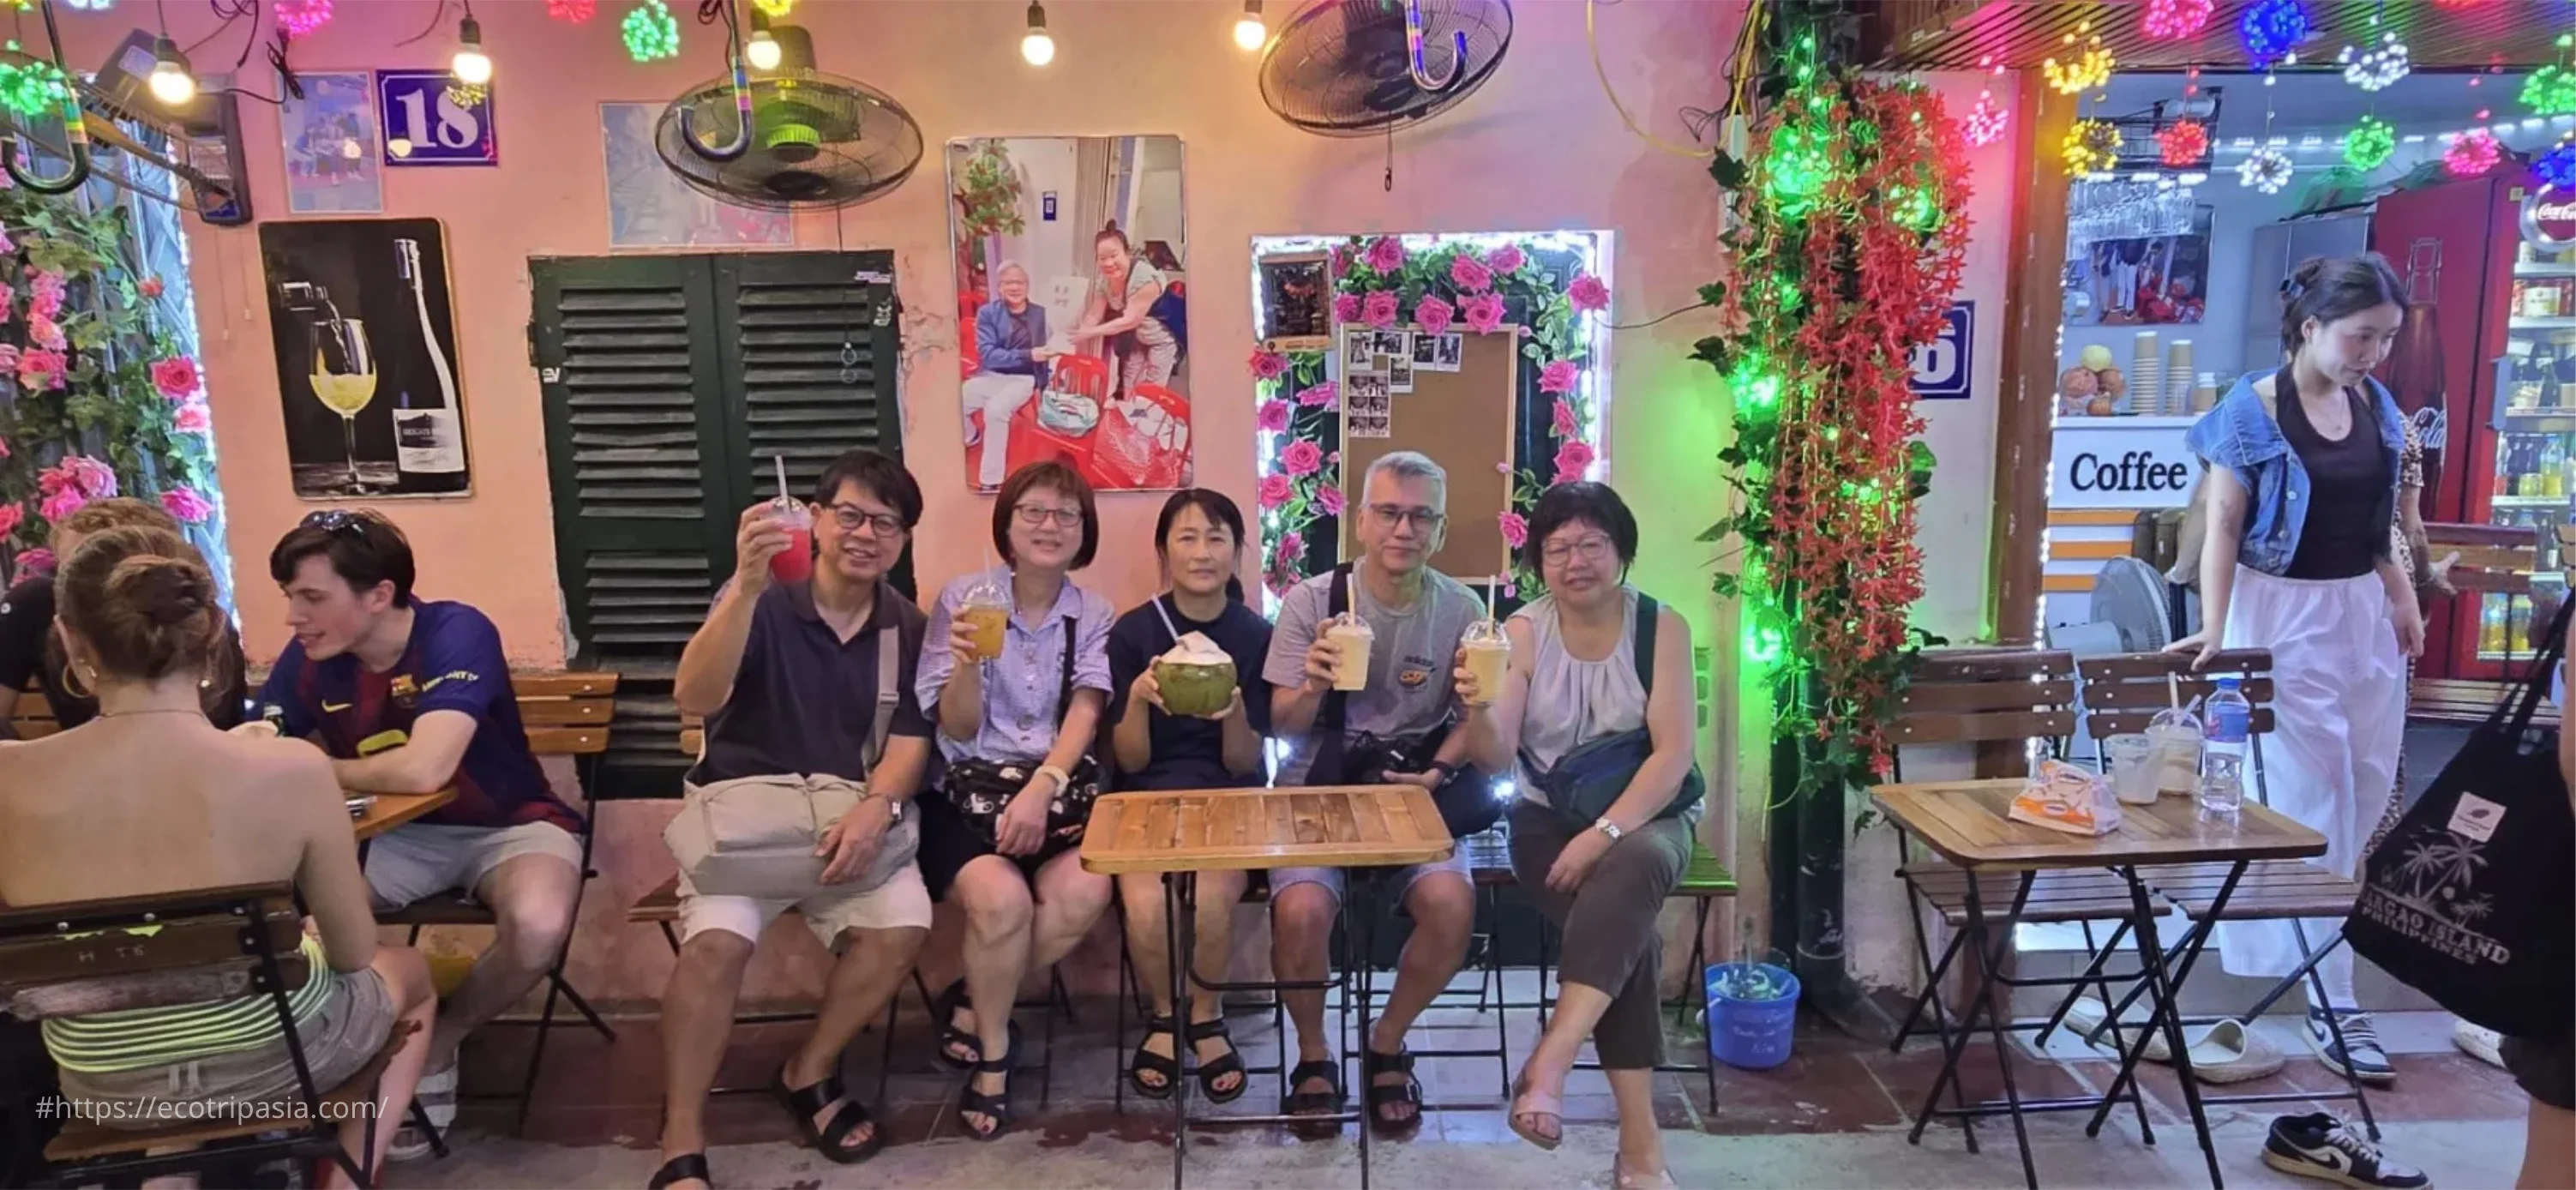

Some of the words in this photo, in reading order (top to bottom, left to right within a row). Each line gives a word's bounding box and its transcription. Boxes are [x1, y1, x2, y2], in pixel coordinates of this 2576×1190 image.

[395, 87, 479, 149] 18
[2070, 451, 2188, 491] Coffee
[2428, 921, 2511, 965] ISLAND
